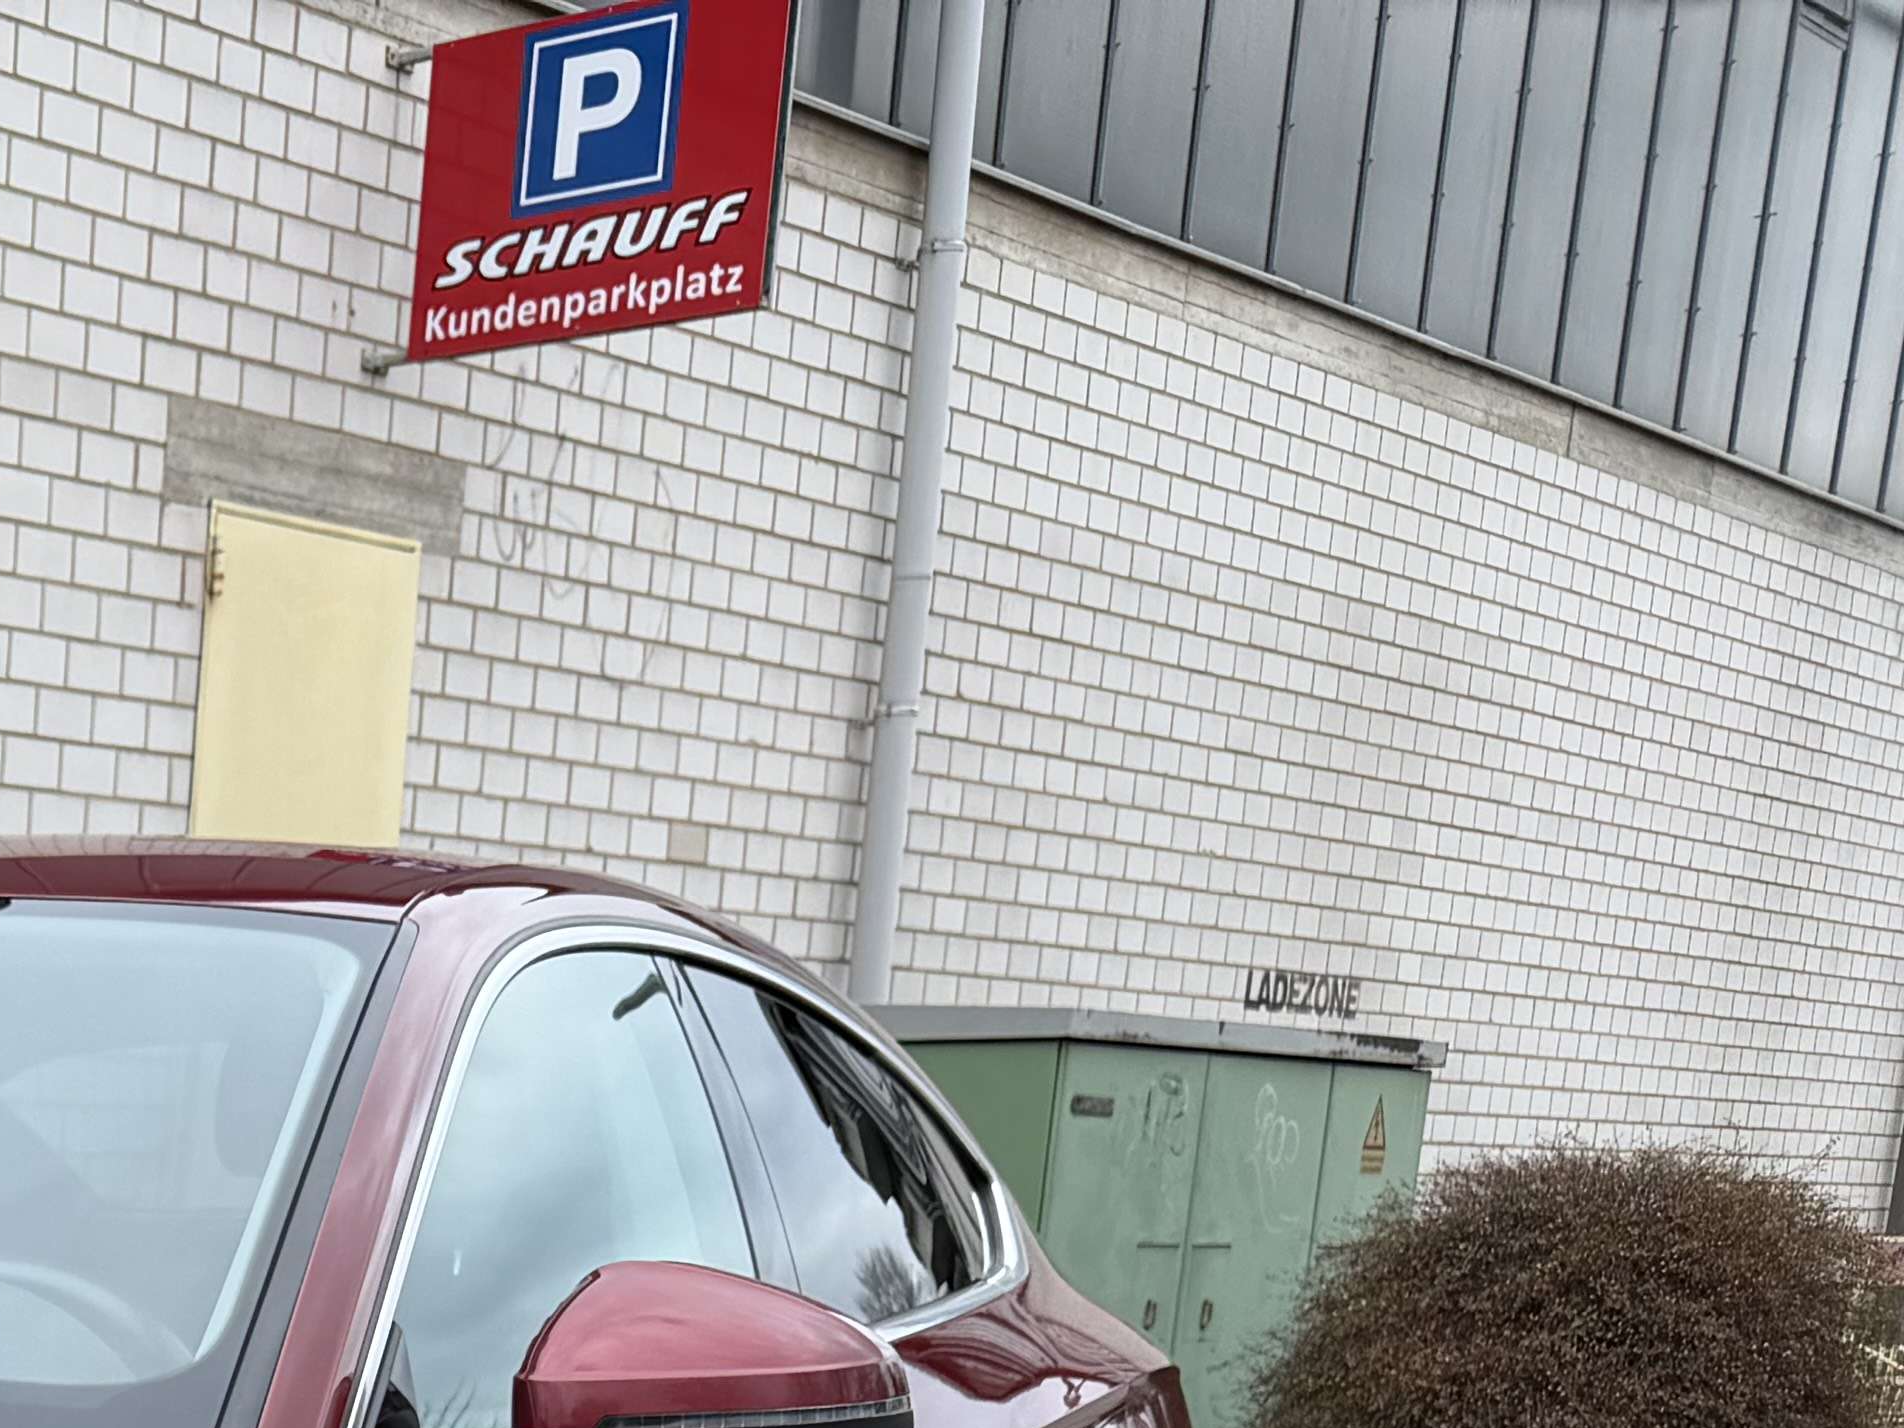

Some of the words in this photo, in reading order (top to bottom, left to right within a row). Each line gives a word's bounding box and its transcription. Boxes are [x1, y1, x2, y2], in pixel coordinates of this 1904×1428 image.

[552, 48, 643, 182] P
[432, 187, 752, 290] SCHAUFF
[425, 264, 744, 343] Kundenparkplatz
[1244, 969, 1360, 1019] LADEZONE
